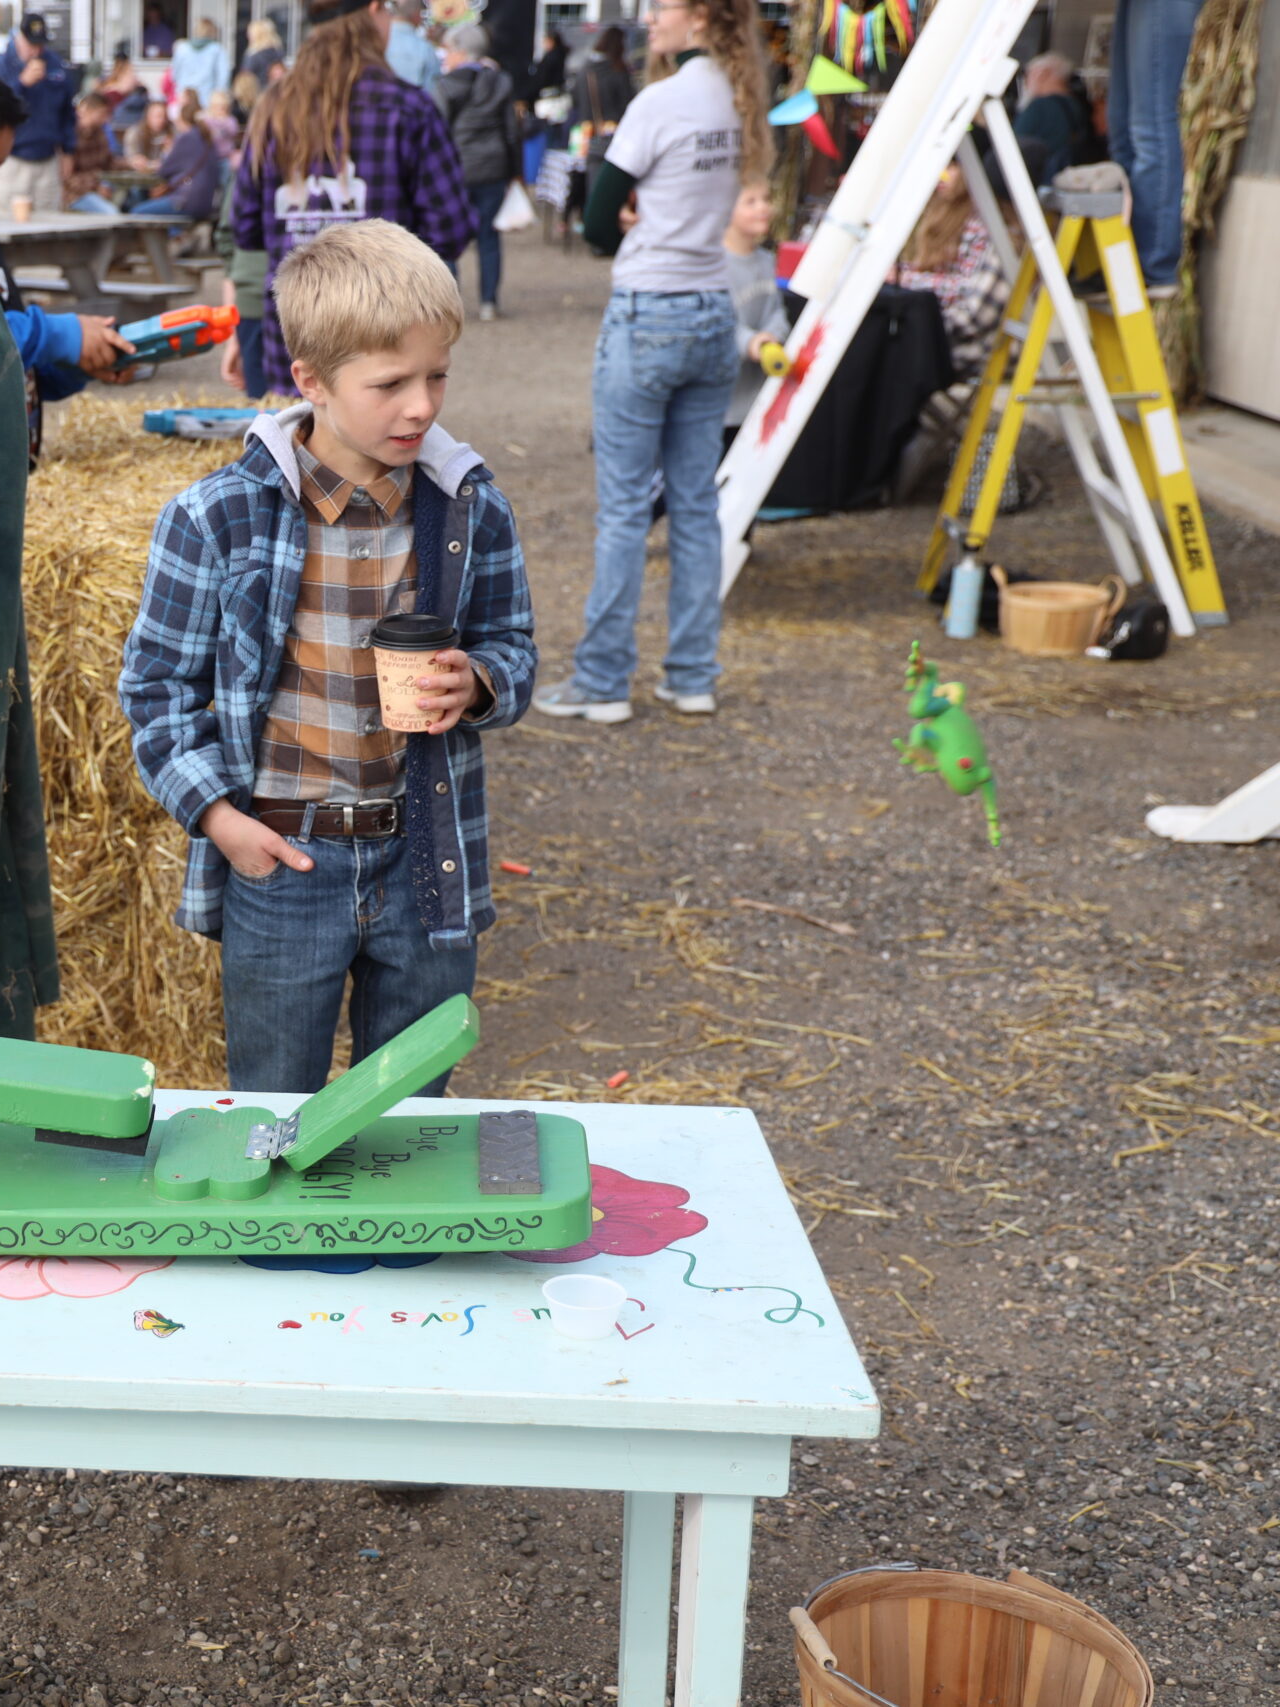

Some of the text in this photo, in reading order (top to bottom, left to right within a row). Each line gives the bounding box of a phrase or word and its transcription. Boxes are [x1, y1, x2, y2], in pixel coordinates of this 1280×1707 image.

[1174, 504, 1204, 573] KELLER
[406, 1125, 459, 1151] Bye
[359, 1152, 410, 1178] Bye
[308, 1305, 366, 1335] You
